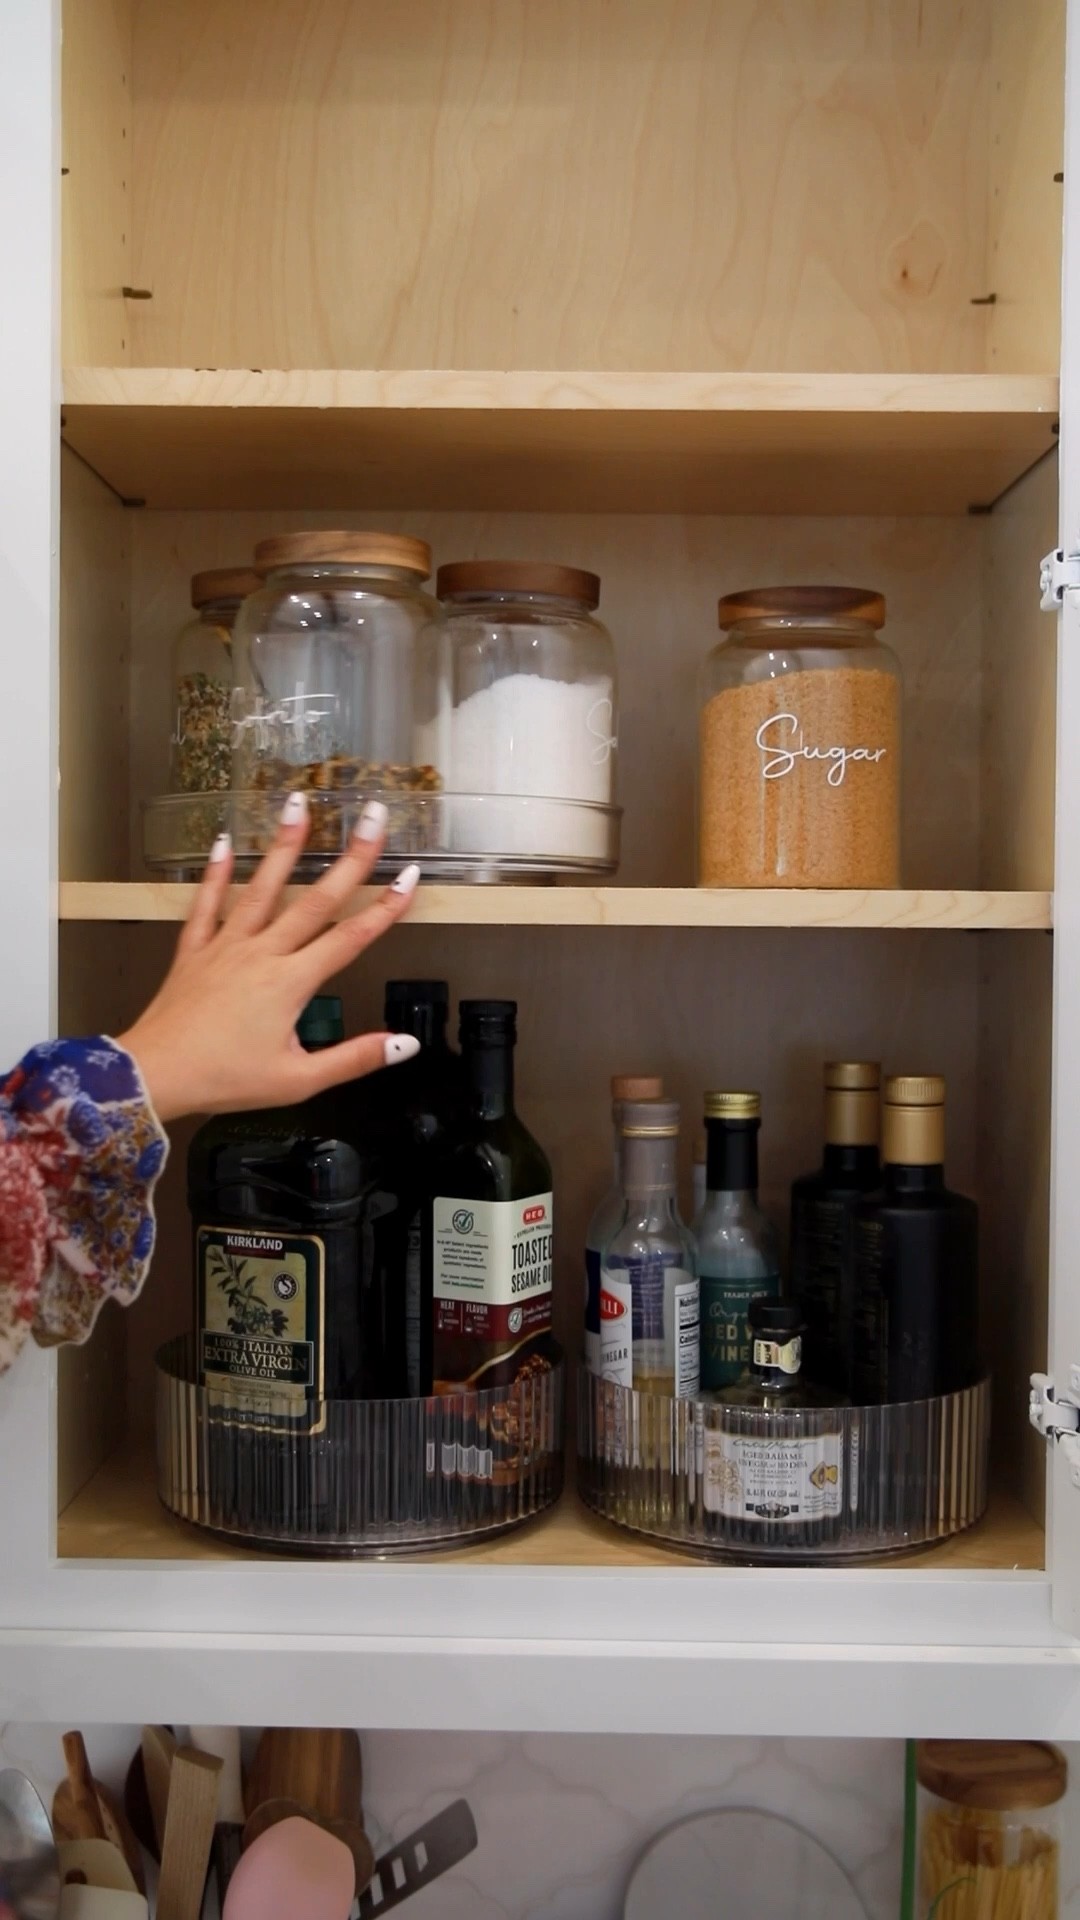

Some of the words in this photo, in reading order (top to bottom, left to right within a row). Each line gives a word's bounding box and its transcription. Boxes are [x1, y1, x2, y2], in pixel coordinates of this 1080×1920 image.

[756, 713, 887, 787] Sugar
[226, 1235, 284, 1251] KIRKLAND
[511, 1267, 541, 1293] SESAME
[440, 1300, 455, 1311] HEAT
[466, 1303, 488, 1315] FLAVOR
[243, 1341, 294, 1356] ITALIAN
[204, 1345, 249, 1365] EXTRA
[251, 1352, 307, 1371] VIRGIN
[229, 1364, 257, 1376] OLIVE
[259, 1368, 277, 1378] OIL
